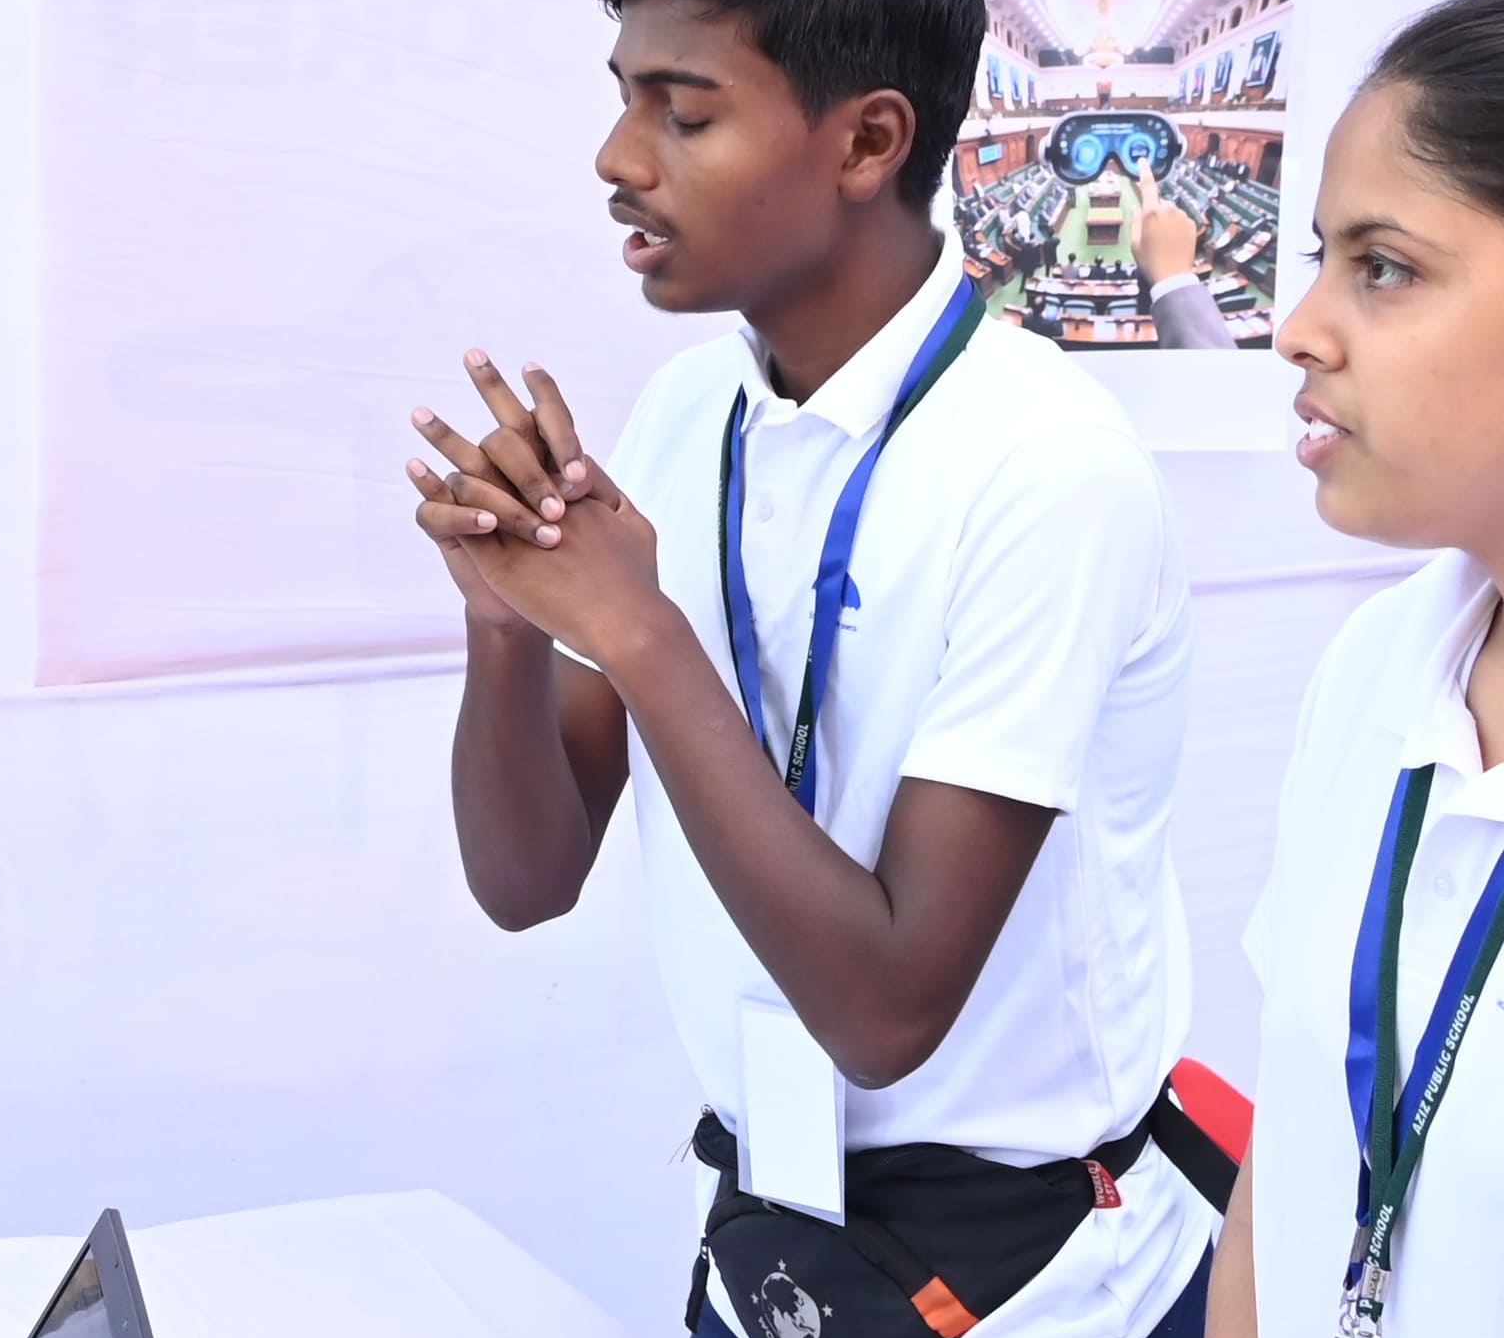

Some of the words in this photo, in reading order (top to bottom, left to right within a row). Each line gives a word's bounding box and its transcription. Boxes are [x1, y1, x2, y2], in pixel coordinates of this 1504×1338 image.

[792, 724, 809, 767] SCHOOL
[1412, 1099, 1431, 1136] AZIZ
[1424, 1049, 1451, 1102] PUBLIC
[1445, 994, 1475, 1050] SCHOOL
[1369, 1204, 1394, 1258] SCHOOL
